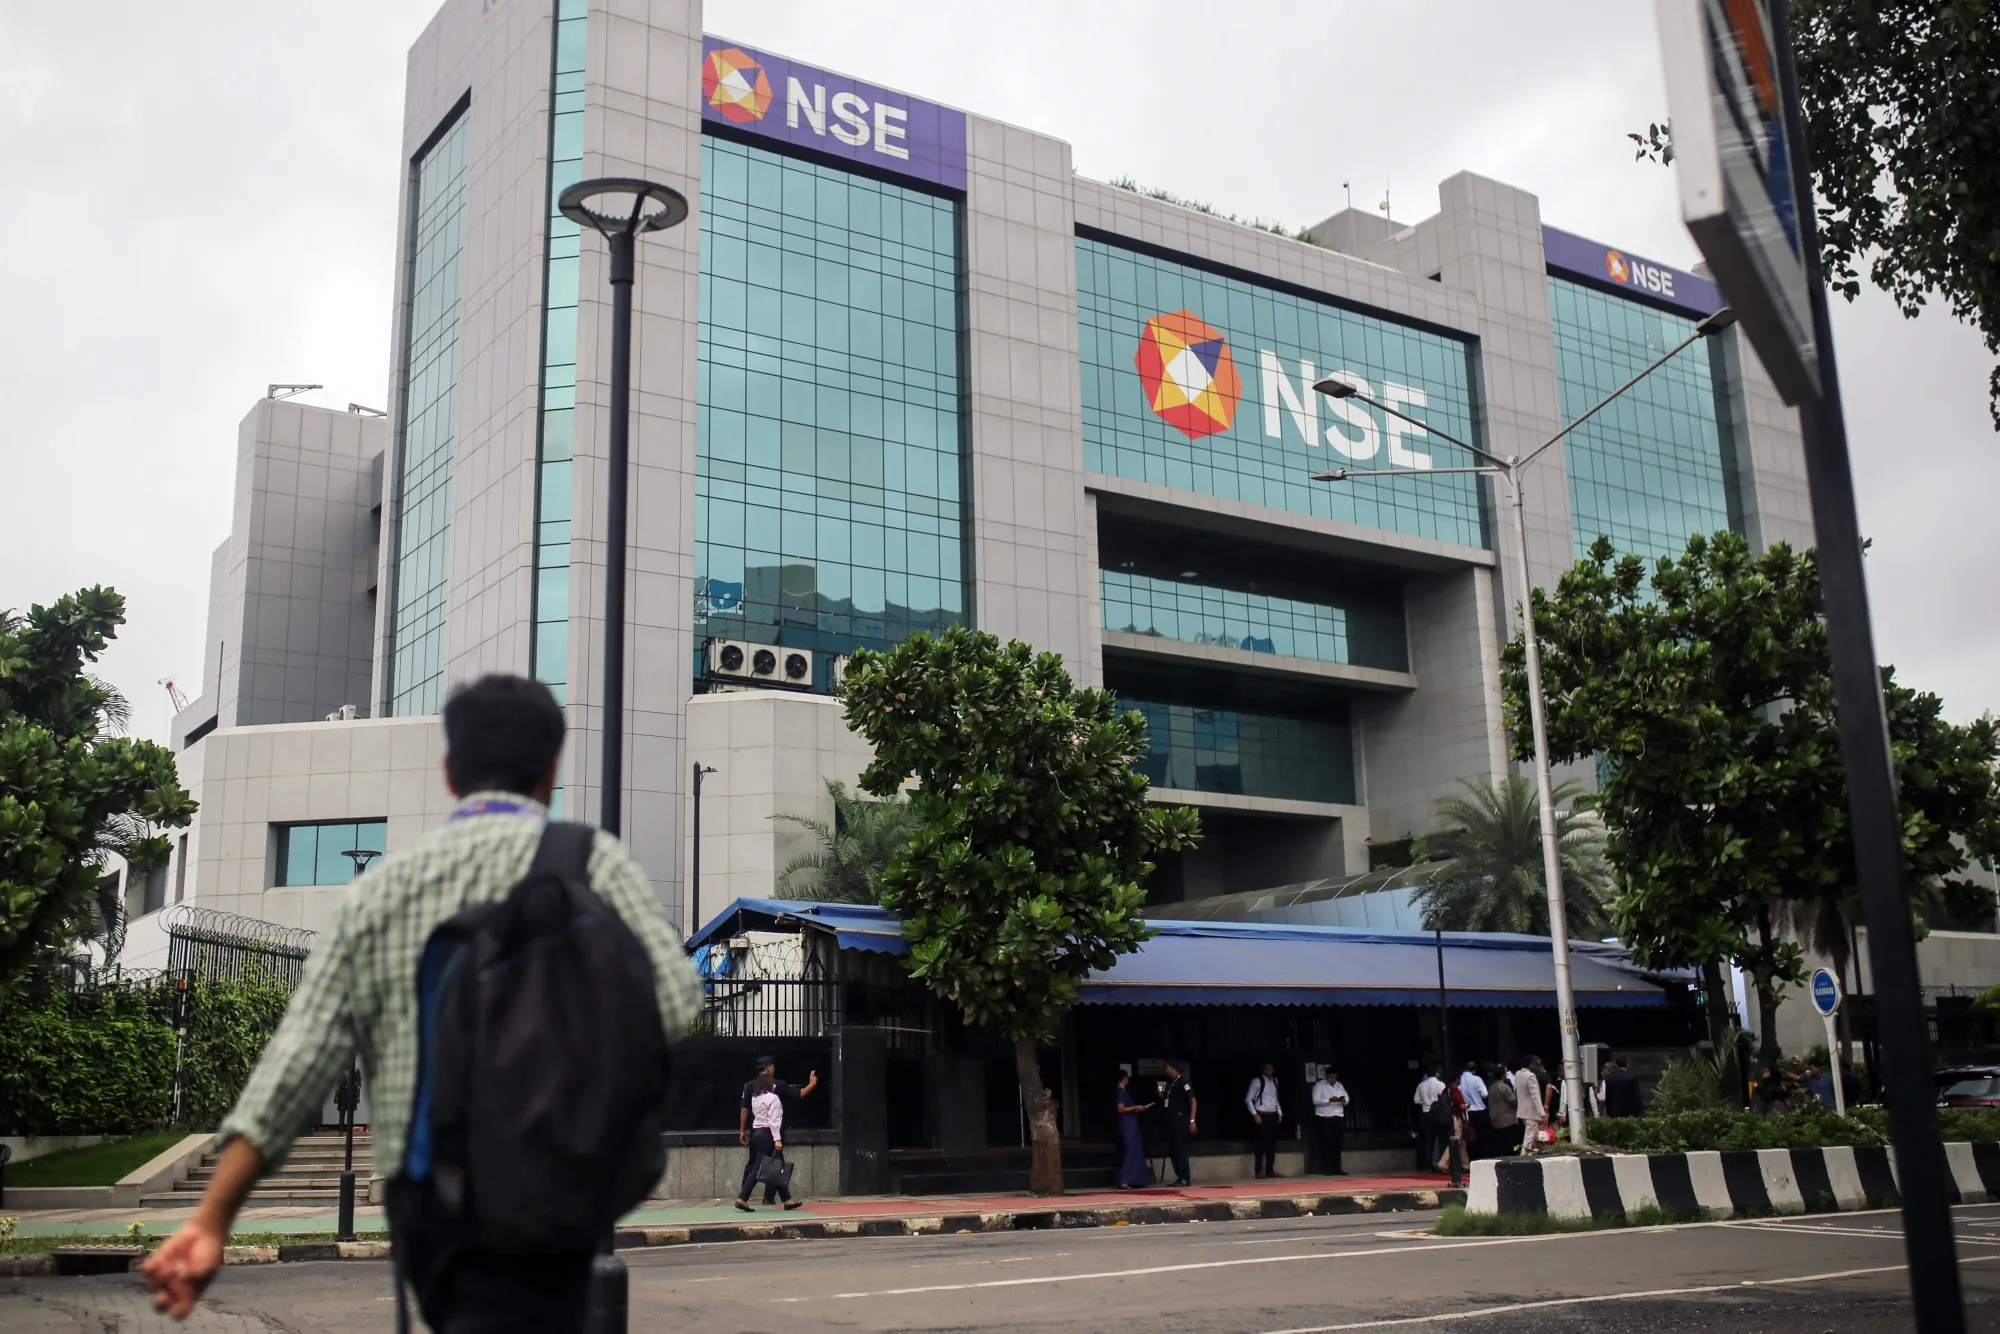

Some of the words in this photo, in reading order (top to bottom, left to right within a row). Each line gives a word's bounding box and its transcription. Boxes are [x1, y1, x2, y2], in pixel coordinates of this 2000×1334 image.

[786, 76, 910, 160] NSE
[1631, 260, 1675, 297] NSE
[1260, 349, 1433, 471] NSE
